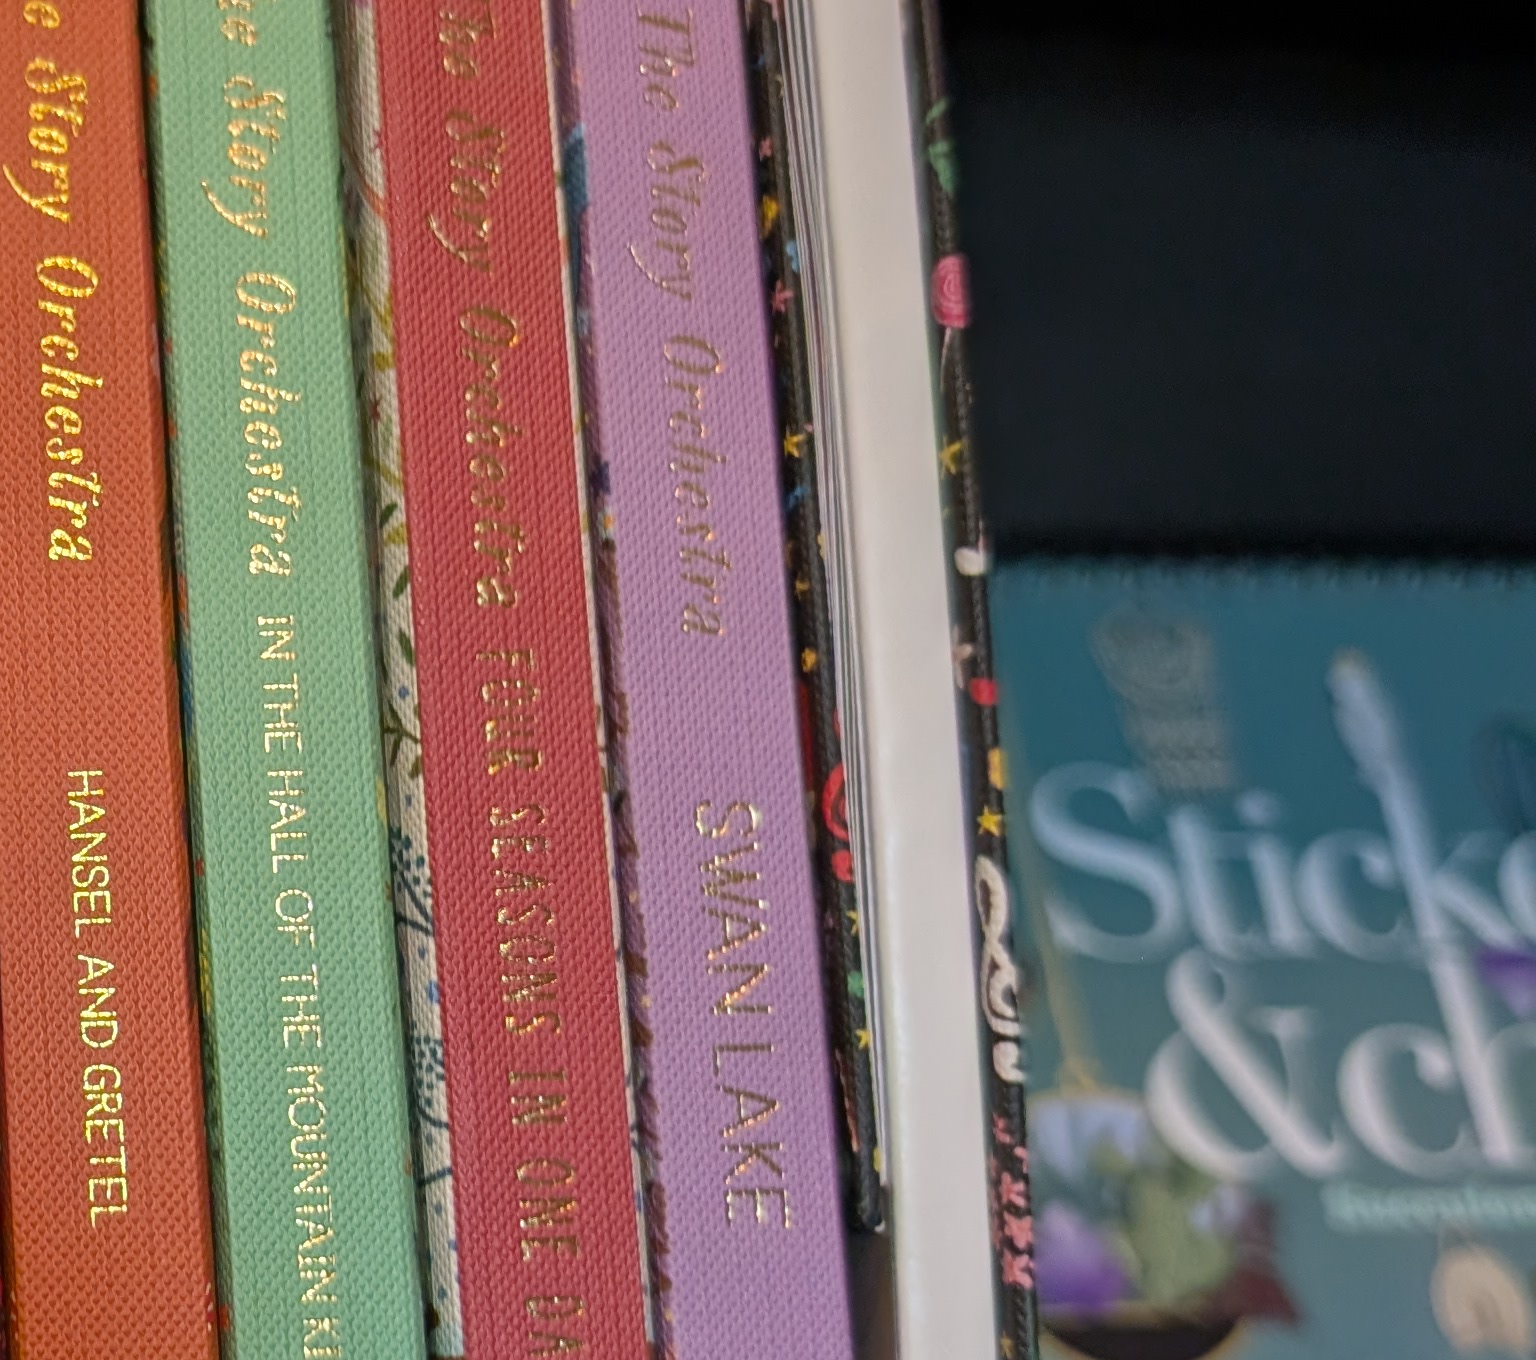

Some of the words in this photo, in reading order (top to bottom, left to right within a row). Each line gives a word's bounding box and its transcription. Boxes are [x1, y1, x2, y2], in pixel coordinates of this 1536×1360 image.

[2, 56, 89, 223] Story
[636, 8, 698, 113] The
[200, 73, 287, 238] Story
[426, 110, 506, 274] Story
[627, 138, 711, 302] Story
[35, 254, 105, 563] Orchestra
[235, 270, 303, 578] Orchestra
[458, 304, 526, 609] Orchestra
[662, 334, 733, 639] Orchestra
[256, 613, 295, 662] IN
[260, 673, 303, 754] THE
[475, 646, 543, 777] FOUR
[65, 767, 113, 939] HANSEL
[265, 769, 311, 876] HALL
[273, 887, 315, 949] OF
[488, 800, 564, 1039] SEASONS
[694, 798, 773, 1018] SWAN
[75, 953, 120, 1050] AND
[278, 964, 322, 1050] THE
[80, 1063, 129, 1229] GRETEL
[506, 1067, 569, 1127] IN
[711, 1043, 793, 1232] LAKE
[282, 1063, 340, 1304] MOUNTAIN
[515, 1156, 580, 1263] ONE
